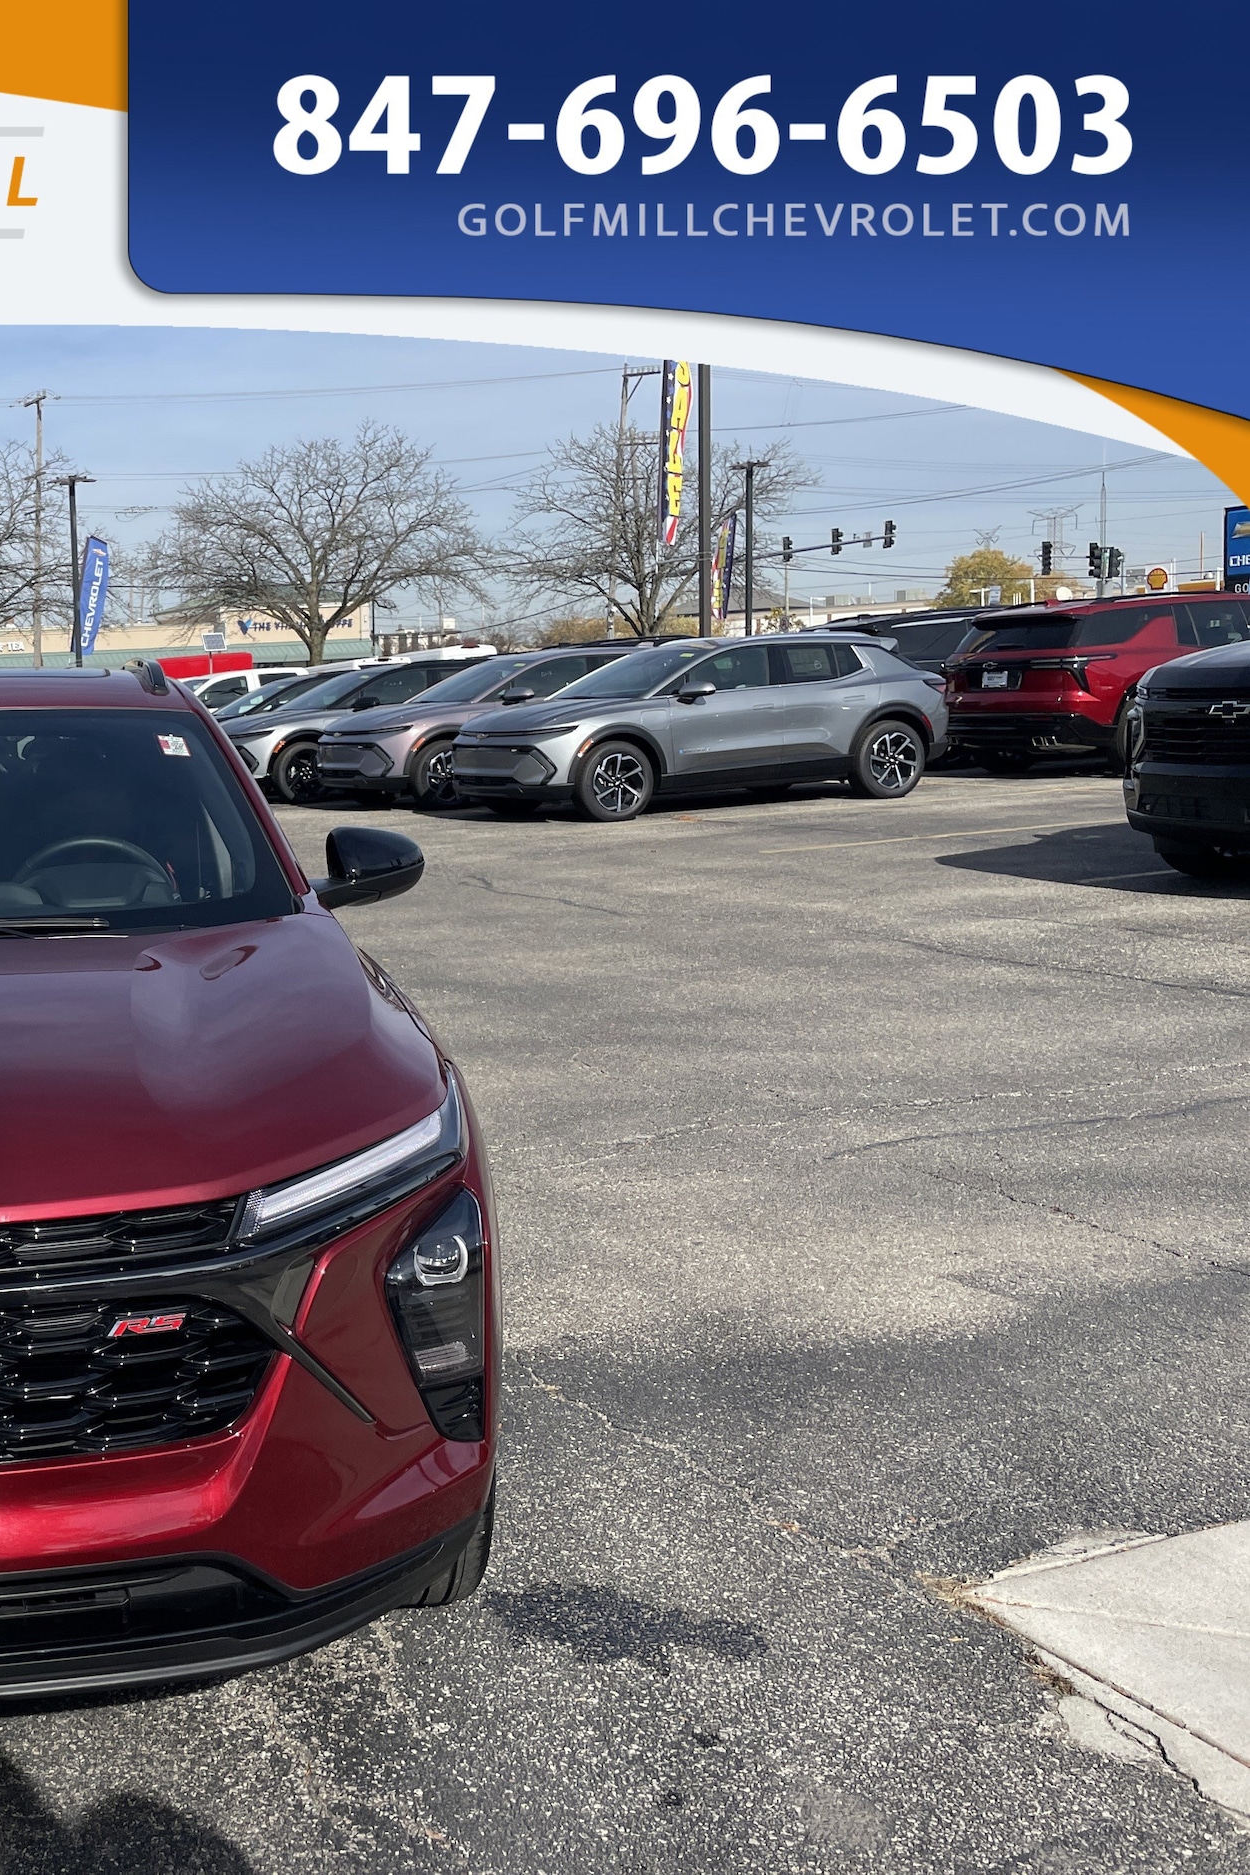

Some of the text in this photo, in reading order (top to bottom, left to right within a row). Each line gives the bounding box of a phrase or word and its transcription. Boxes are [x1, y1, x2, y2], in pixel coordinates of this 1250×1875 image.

[80, 557, 104, 647] CHEVROLET
[7, 642, 24, 651] TEA
[107, 1312, 187, 1337] RS
